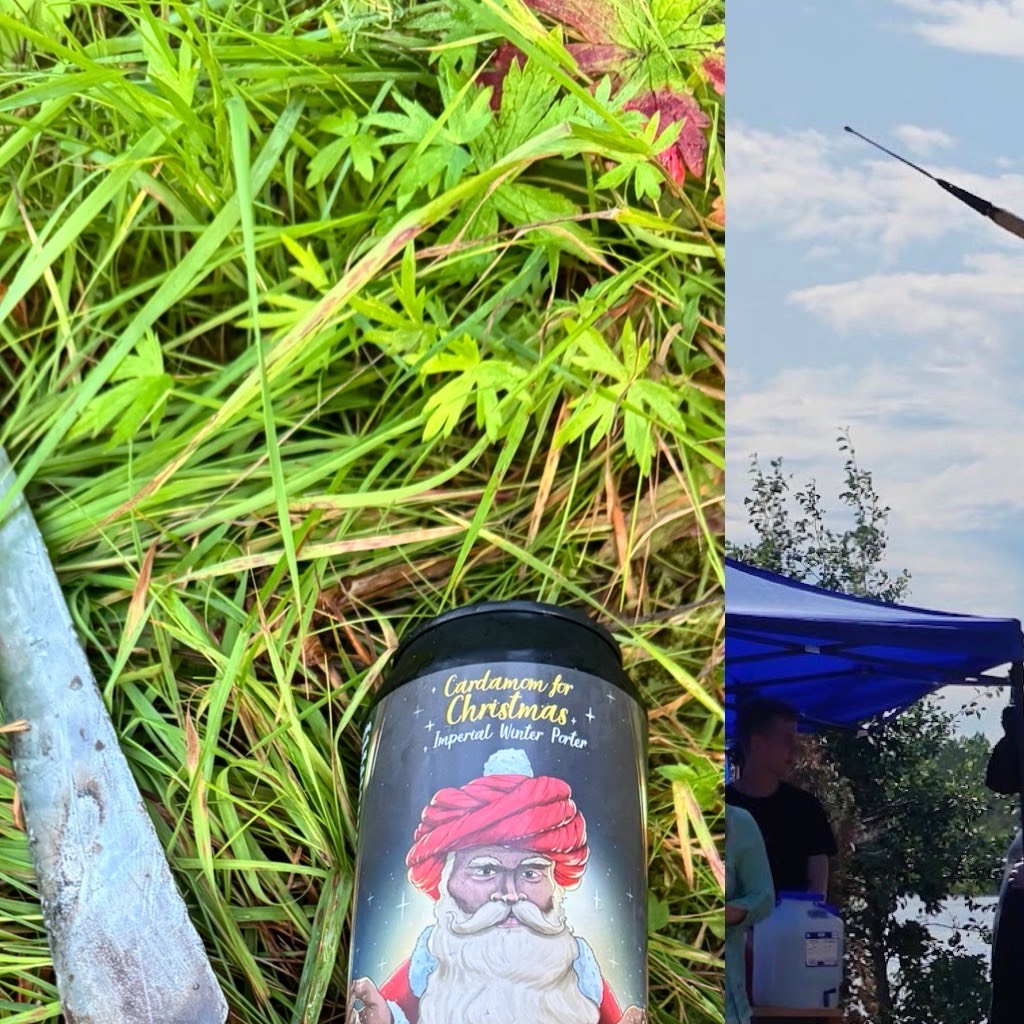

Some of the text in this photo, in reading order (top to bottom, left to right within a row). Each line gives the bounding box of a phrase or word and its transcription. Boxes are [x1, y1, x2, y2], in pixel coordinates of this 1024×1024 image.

[444, 671, 574, 697] Cardamom for
[446, 691, 569, 725] Christmas
[433, 723, 588, 749] Imperial Winter Porter
